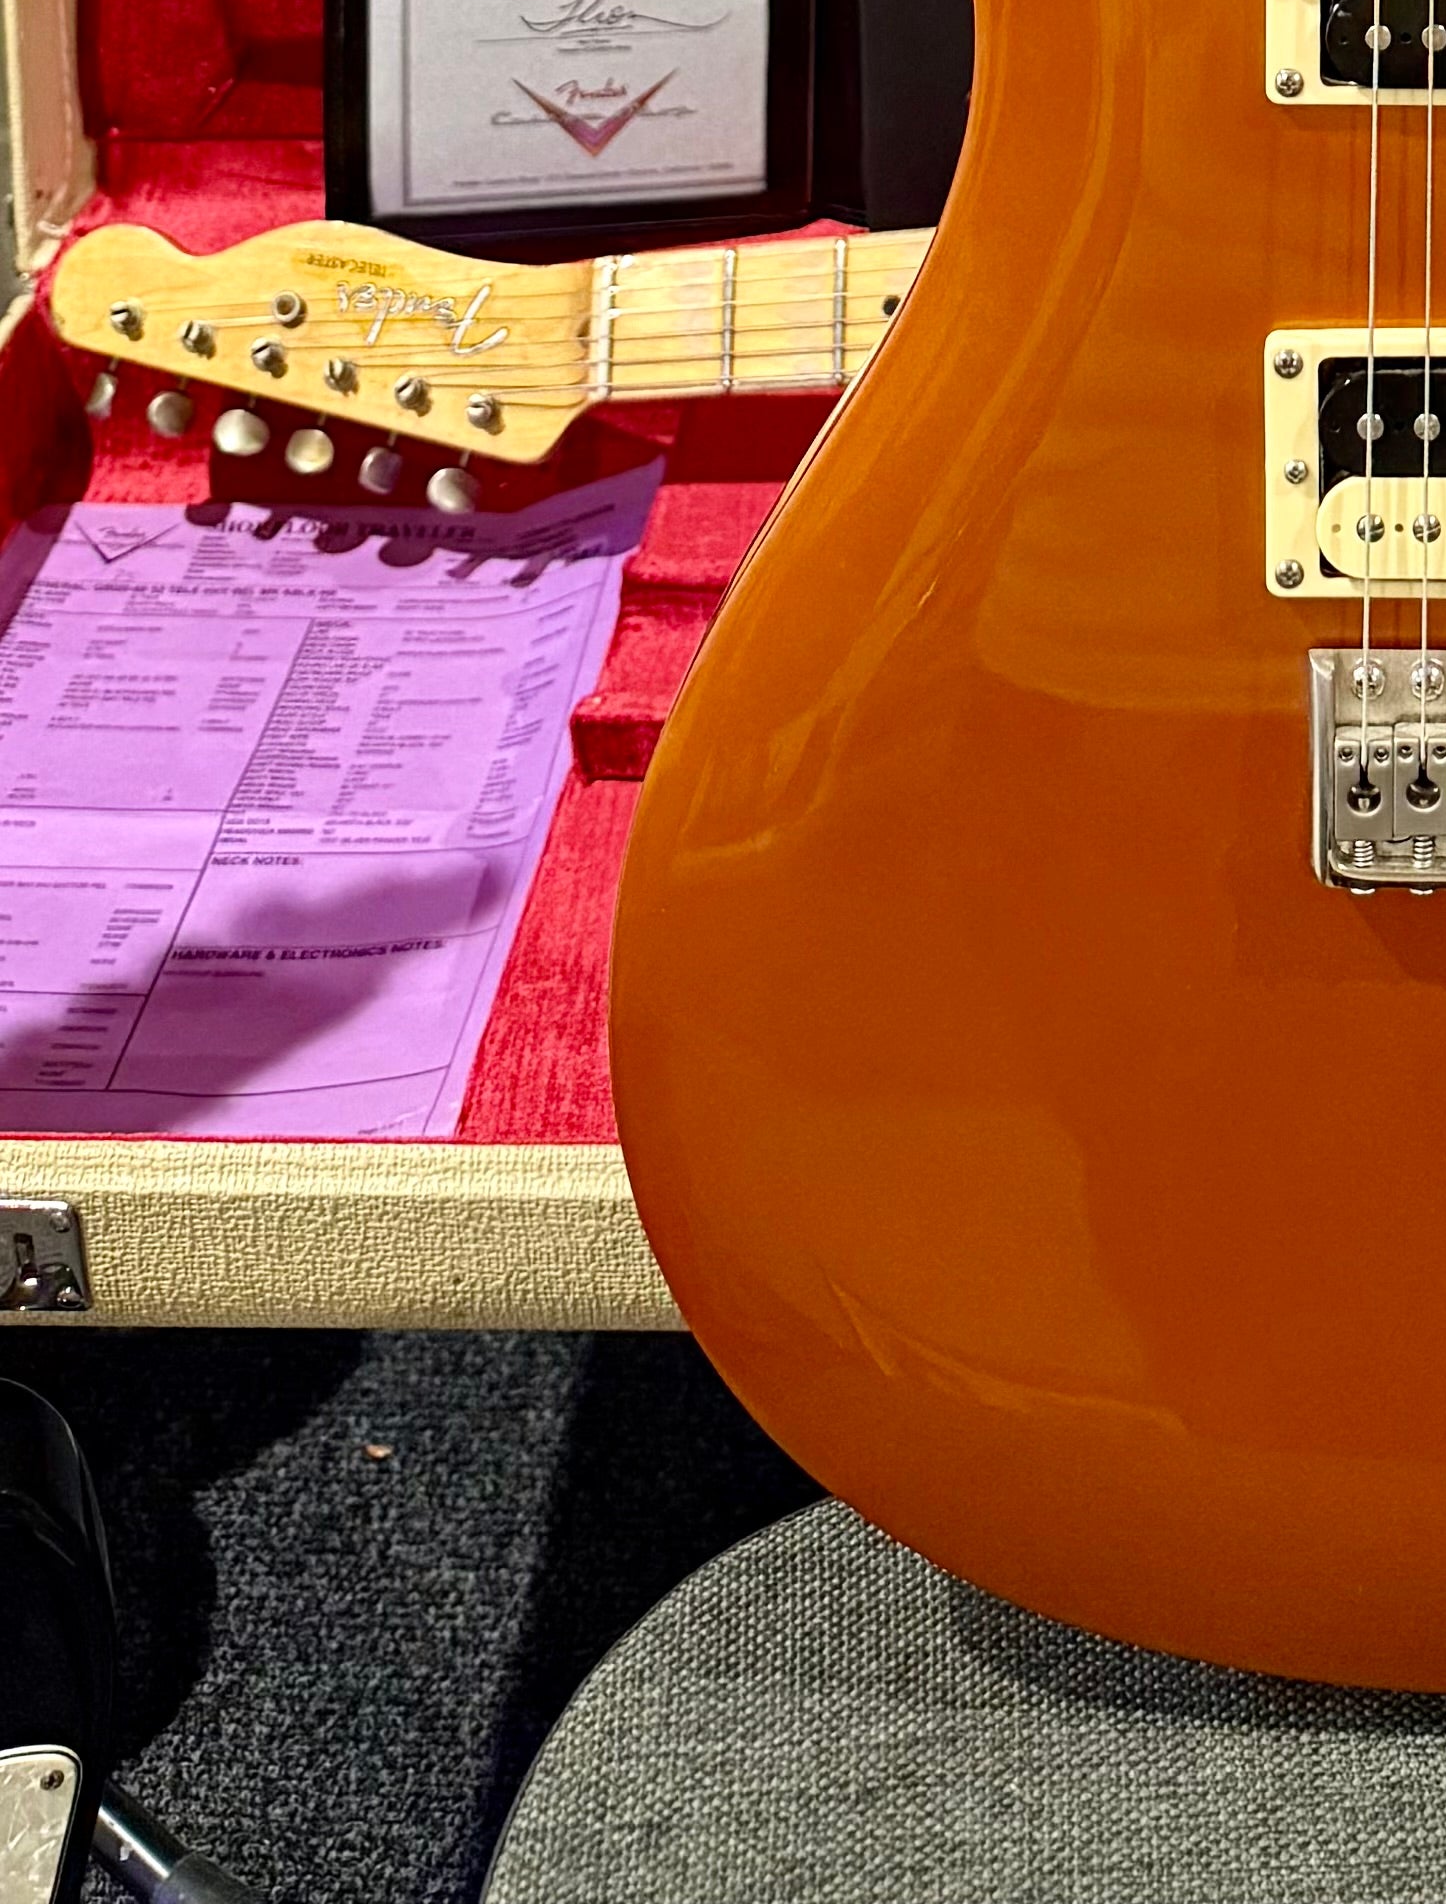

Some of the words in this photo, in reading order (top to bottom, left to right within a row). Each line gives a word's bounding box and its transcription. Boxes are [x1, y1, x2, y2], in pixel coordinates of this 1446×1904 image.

[335, 277, 510, 356] Fender
[171, 947, 263, 962] HARDWARE
[280, 945, 387, 961] ELECTRONICS
